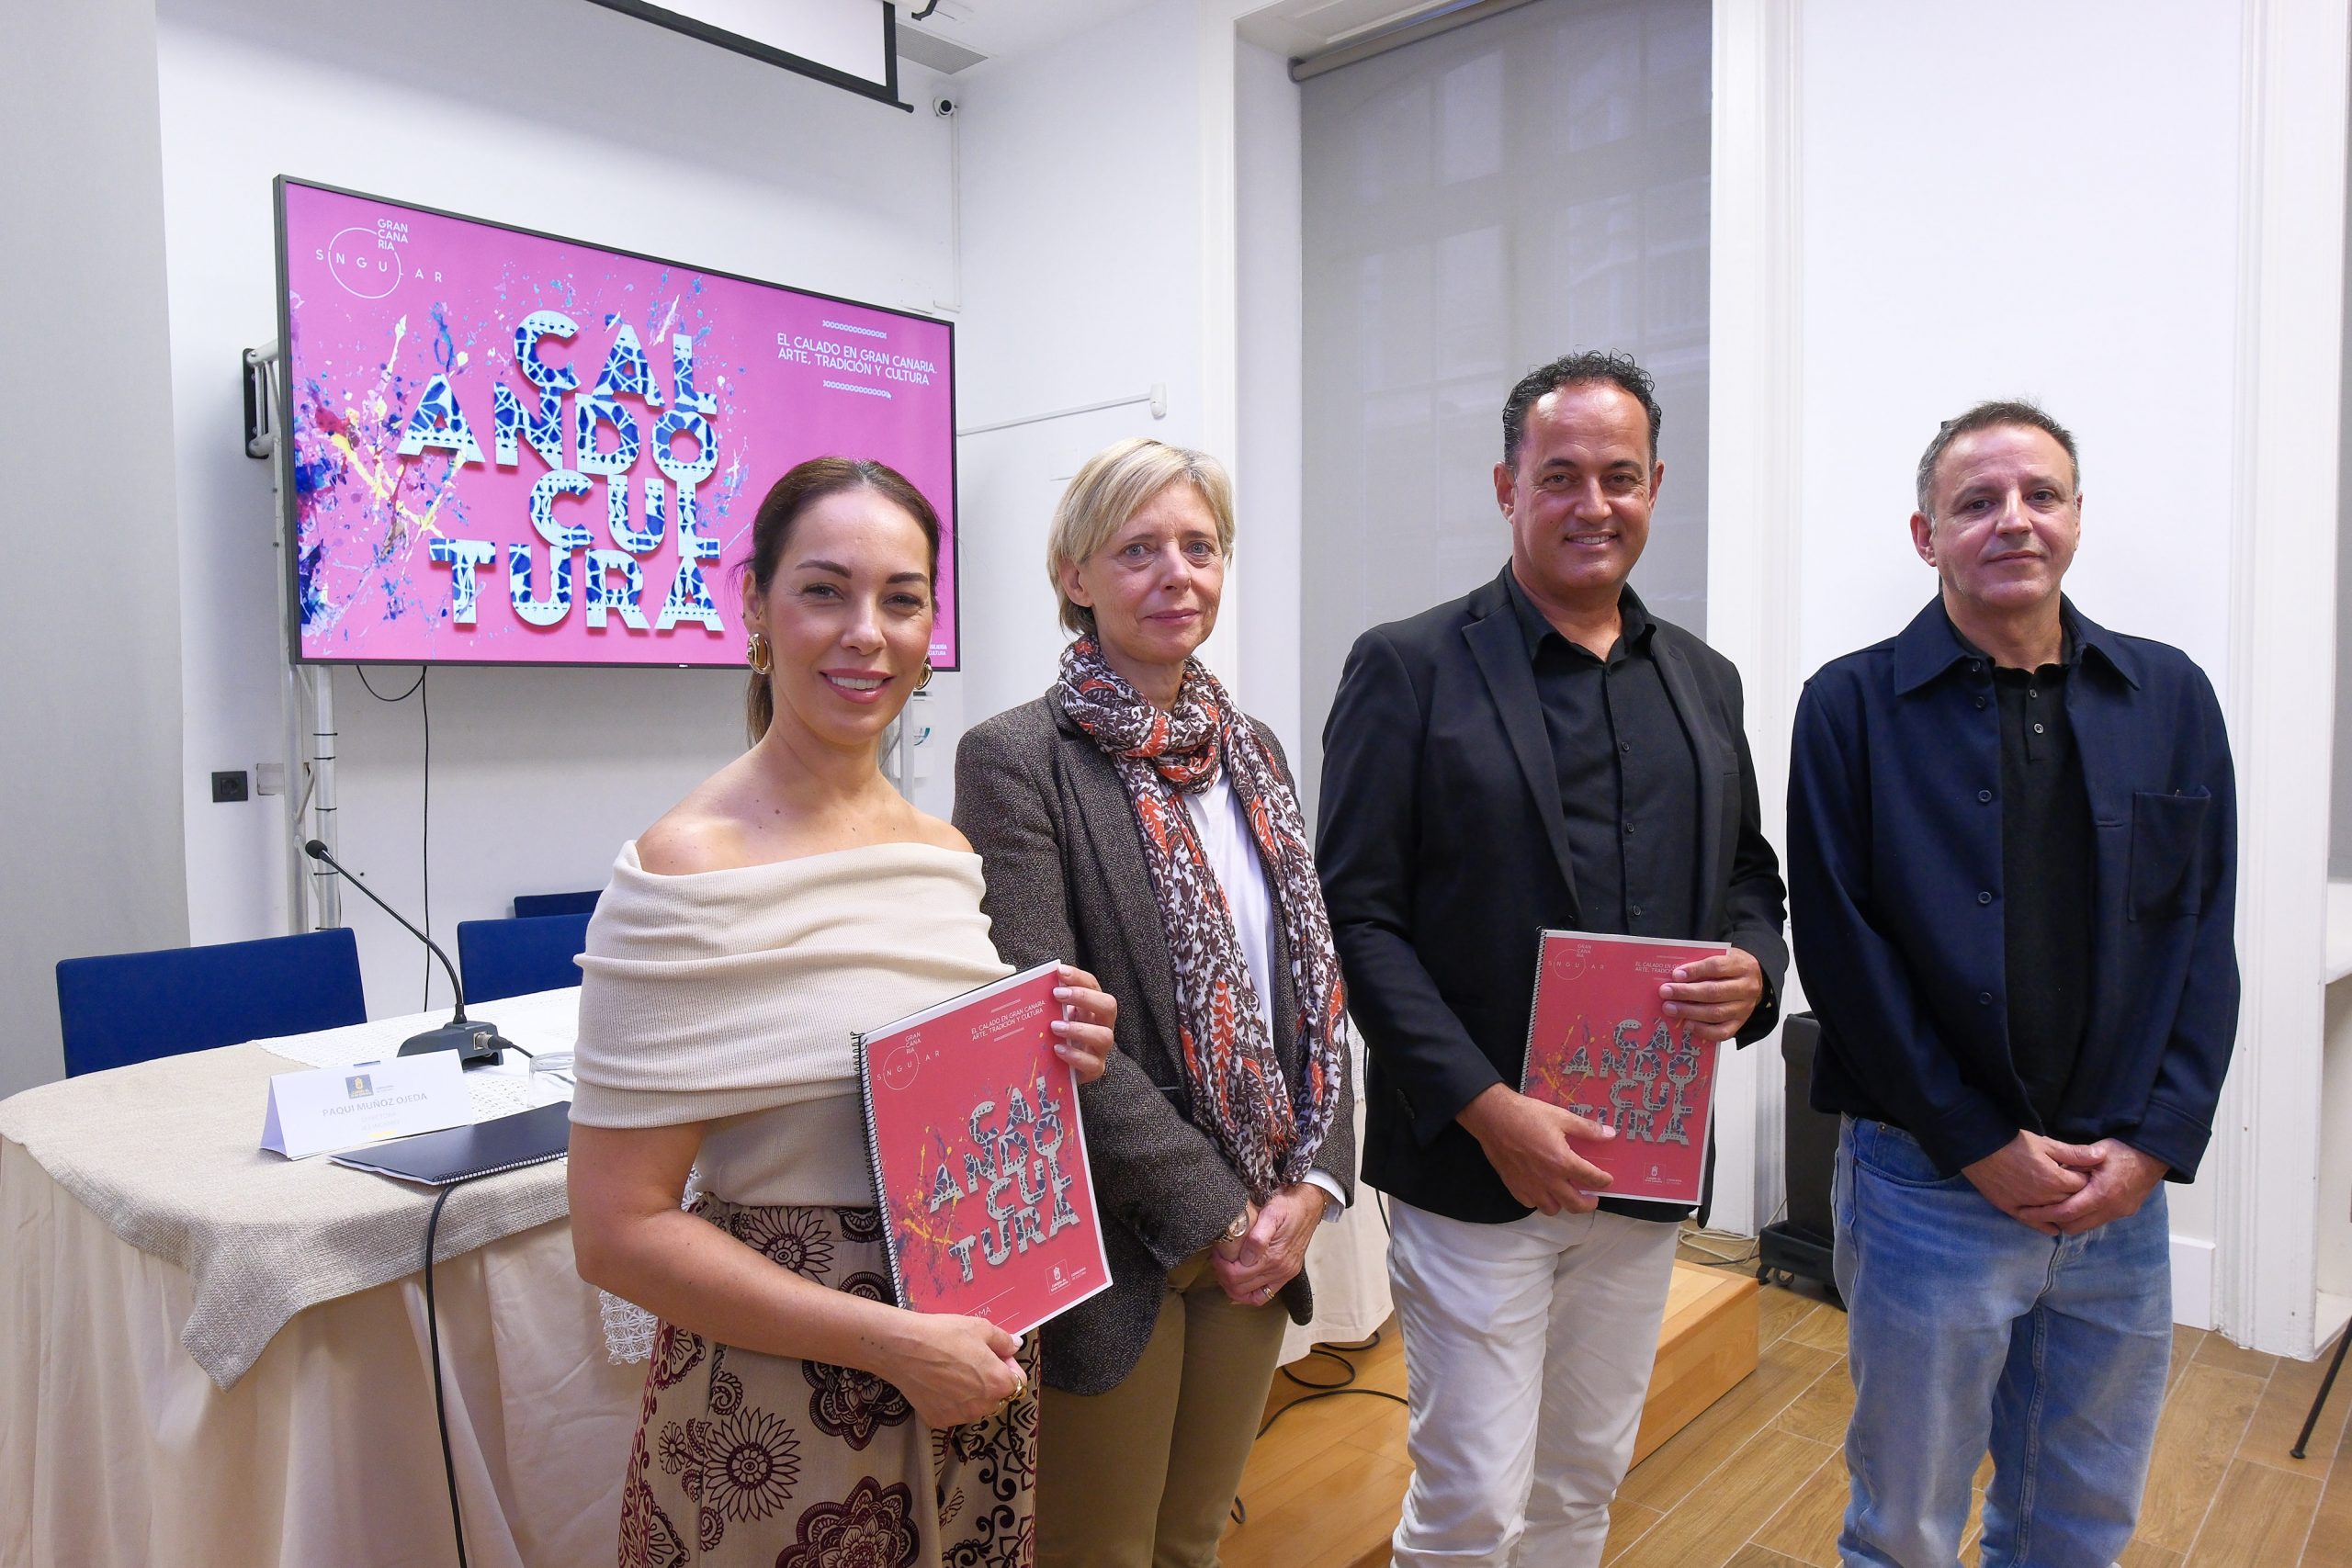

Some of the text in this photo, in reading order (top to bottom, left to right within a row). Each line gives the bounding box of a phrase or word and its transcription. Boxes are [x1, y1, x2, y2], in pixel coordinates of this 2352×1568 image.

[378, 219, 408, 232] GRAN
[378, 229, 408, 243] CANA
[378, 239, 395, 251] RIA
[514, 310, 718, 415] CAL
[777, 333, 790, 346] EL
[794, 336, 841, 355] CALADO
[843, 345, 857, 359] EN
[860, 349, 889, 365] GRAN
[778, 347, 930, 386] ARTE, TRADICIÓN Y CULTURA
[396, 373, 719, 484] ANDO
[529, 469, 721, 558] CUL
[428, 537, 725, 632] TURA
[978, 1019, 1000, 1031] CALADO
[1009, 1008, 1023, 1019] GRAN
[1021, 1007, 1044, 1021] CULTURA
[905, 1032, 921, 1043] GRAN
[905, 1038, 922, 1048] CANA
[1613, 1019, 1701, 1056] CAL
[1562, 1045, 1698, 1086] ANDO
[322, 1092, 428, 1117] PAQUI MUÑOZ OJEDA
[968, 1076, 1060, 1145] CAL
[1610, 1078, 1693, 1114] CUL
[930, 1113, 1064, 1214] ANDO
[986, 1154, 1072, 1221] CUL
[949, 1194, 1081, 1283] TURA
